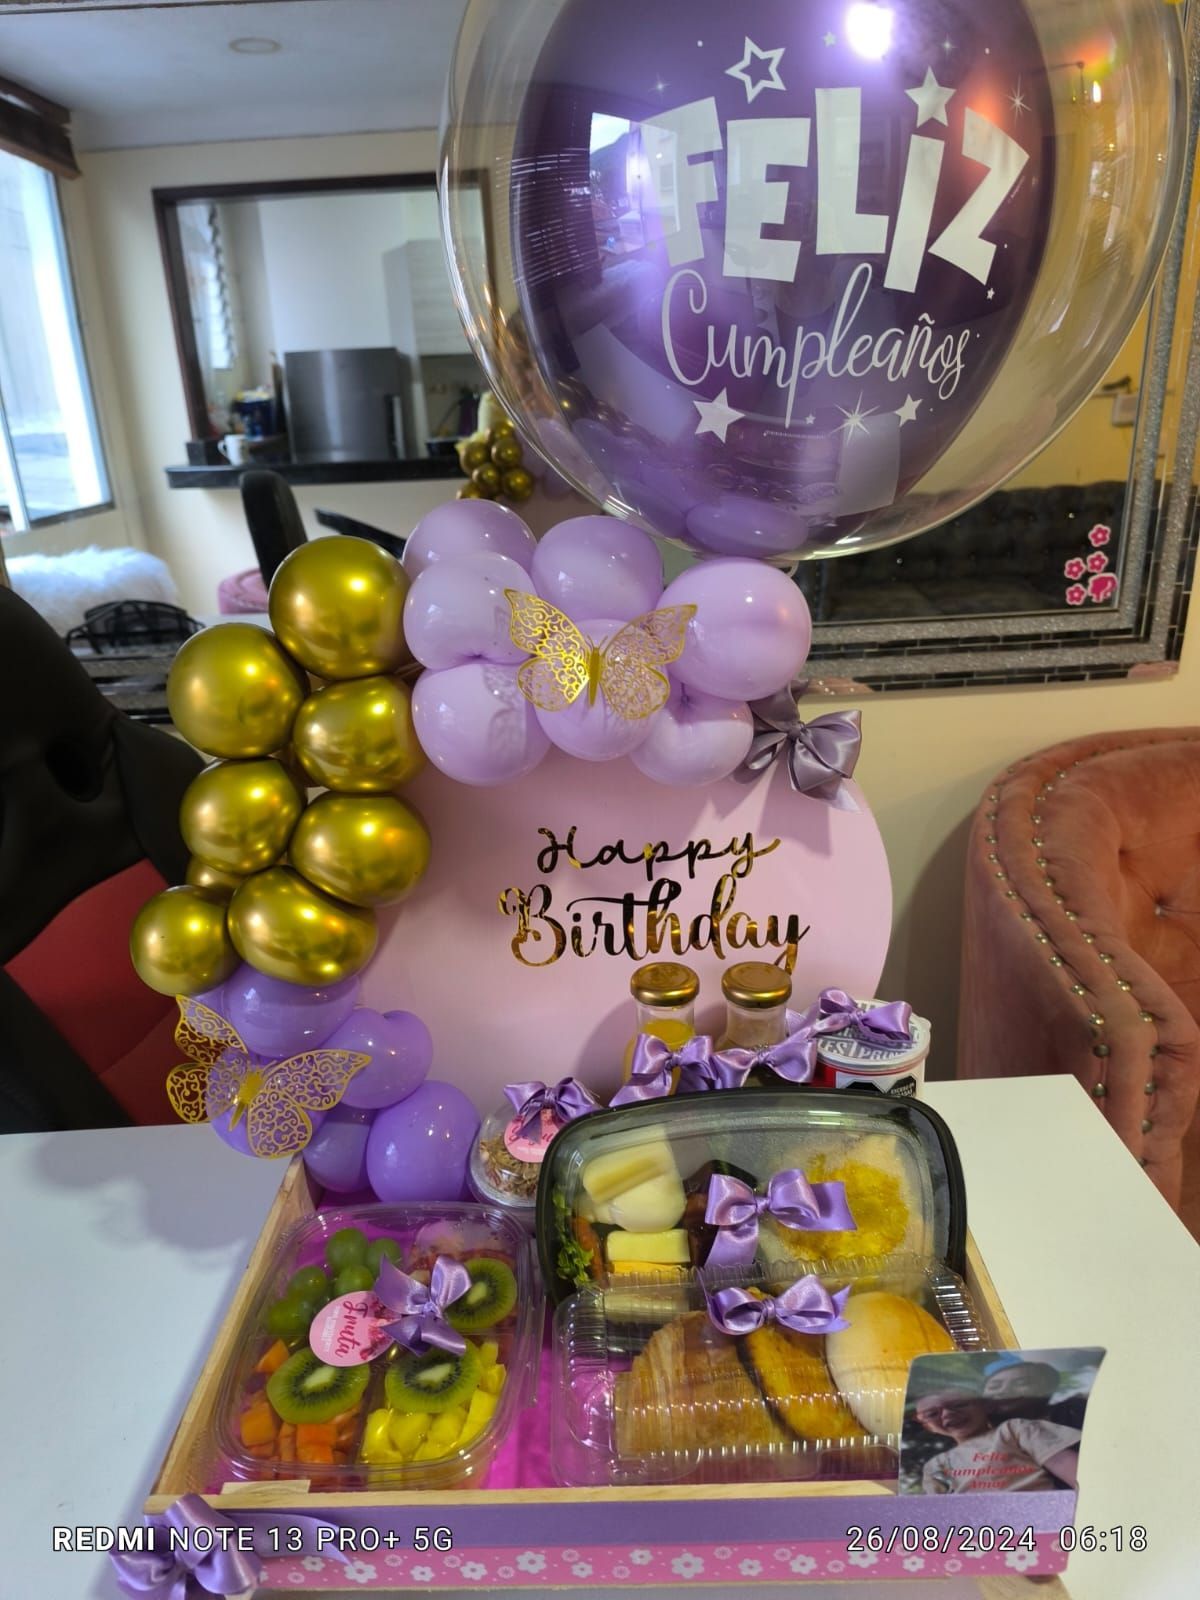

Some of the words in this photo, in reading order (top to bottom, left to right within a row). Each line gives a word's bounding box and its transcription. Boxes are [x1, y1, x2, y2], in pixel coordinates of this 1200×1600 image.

[661, 262, 972, 428] Cumpleaños
[536, 826, 781, 881] Happy
[498, 873, 810, 975] Birthday
[334, 1300, 368, 1358] Fruta
